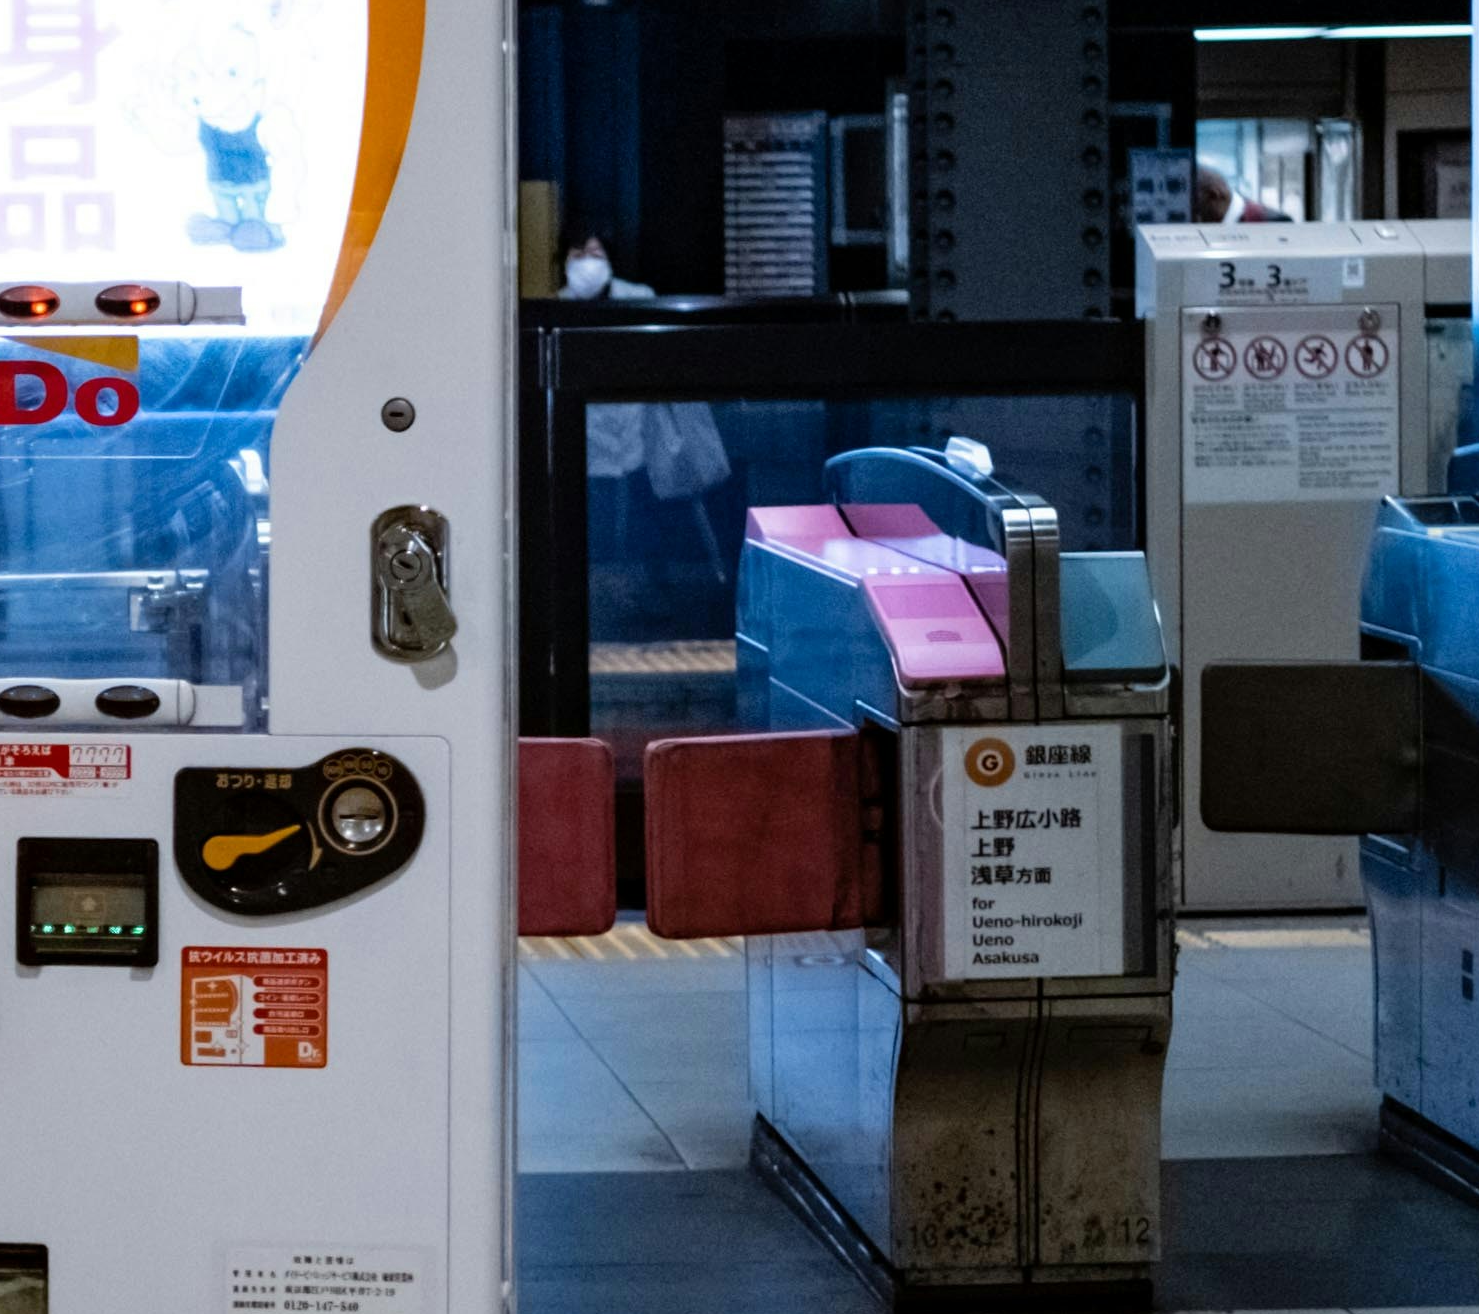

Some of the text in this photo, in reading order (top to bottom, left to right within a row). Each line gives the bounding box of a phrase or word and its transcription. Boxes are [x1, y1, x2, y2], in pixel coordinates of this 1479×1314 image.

[1219, 262, 1282, 289] 3 3
[981, 754, 998, 771] G
[1025, 744, 1091, 766] 銀座線
[214, 773, 293, 790] おつり・返却
[971, 808, 1081, 830] 上野広小路
[971, 837, 1014, 858] 上野
[971, 864, 1052, 885] 浅草方面
[972, 897, 995, 909] for
[972, 913, 1083, 929] Ueno-hirokoji
[972, 935, 1014, 947] Ueno
[188, 950, 322, 965] 抗ウイルス抗菌加工済み
[972, 952, 1040, 965] Asakusa
[1120, 1217, 1150, 1244] 12
